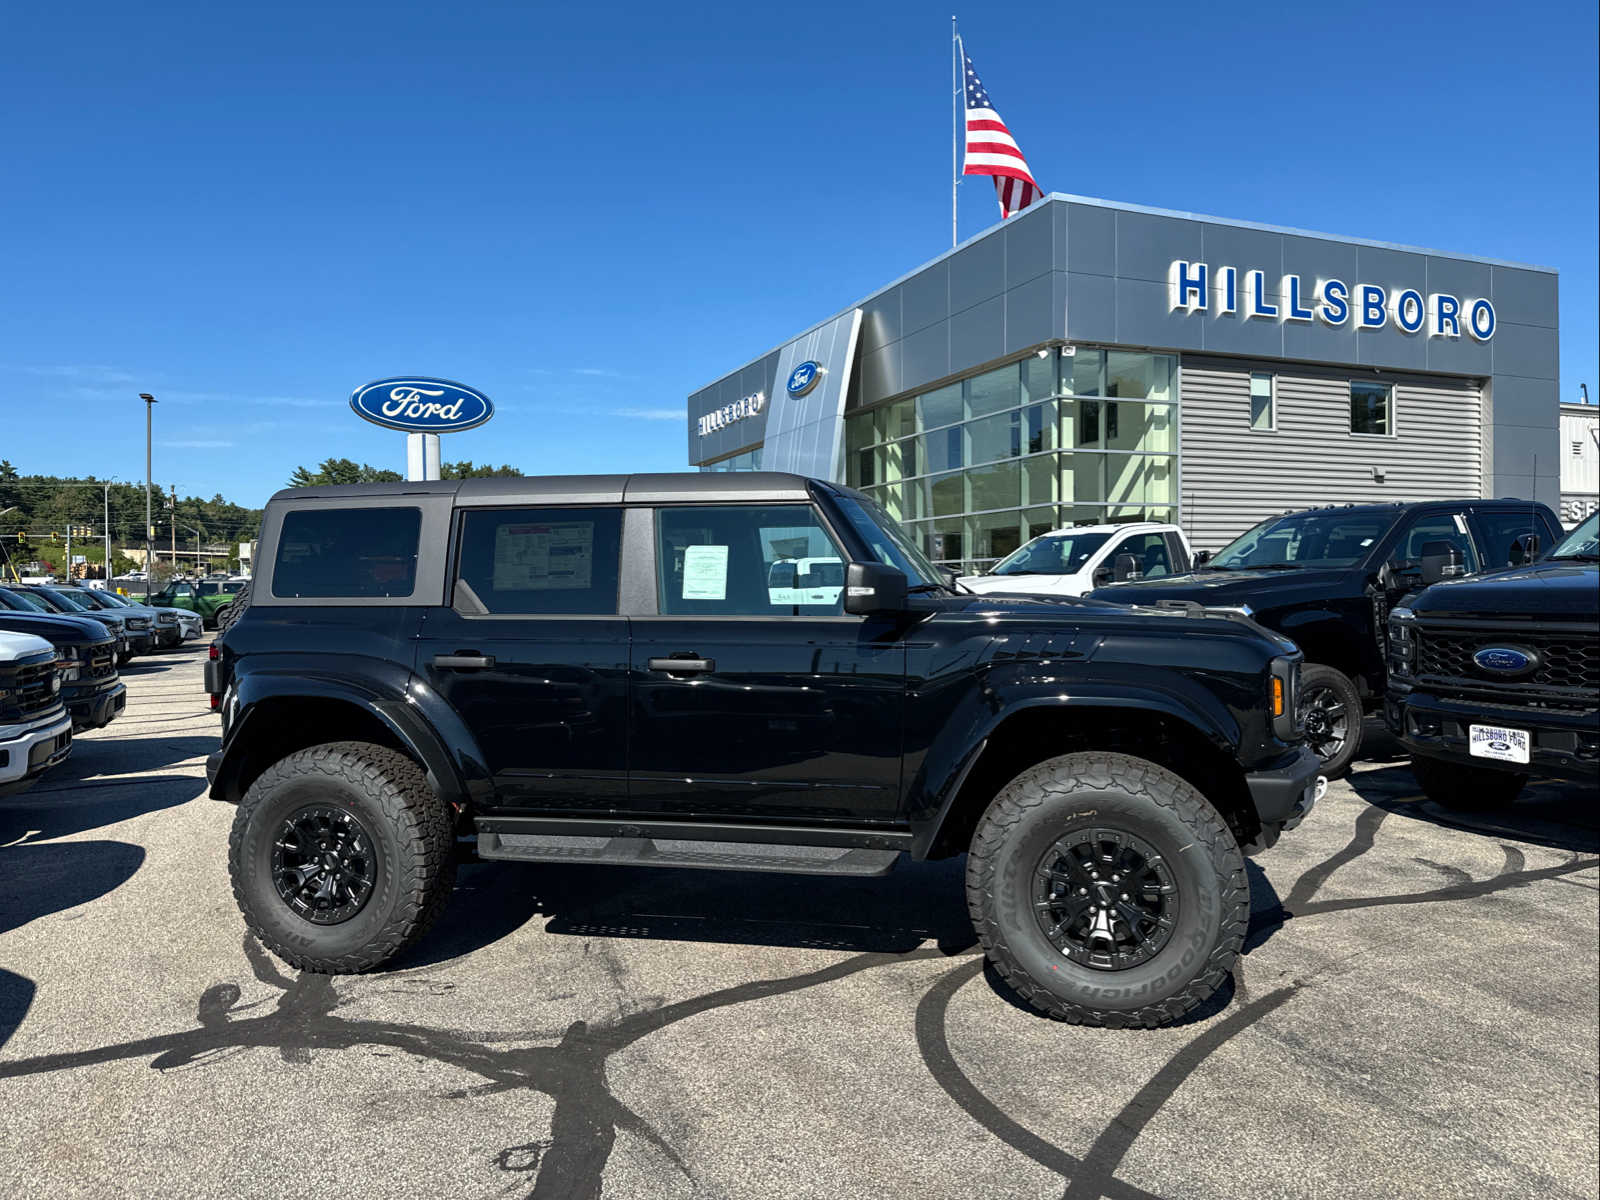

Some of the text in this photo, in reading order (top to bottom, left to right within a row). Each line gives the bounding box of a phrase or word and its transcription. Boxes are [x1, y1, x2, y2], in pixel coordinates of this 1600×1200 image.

[1170, 260, 1496, 341] HILLSBORO
[791, 368, 810, 388] Ford
[382, 386, 465, 420] Ford
[698, 392, 762, 436] HILLSBORO
